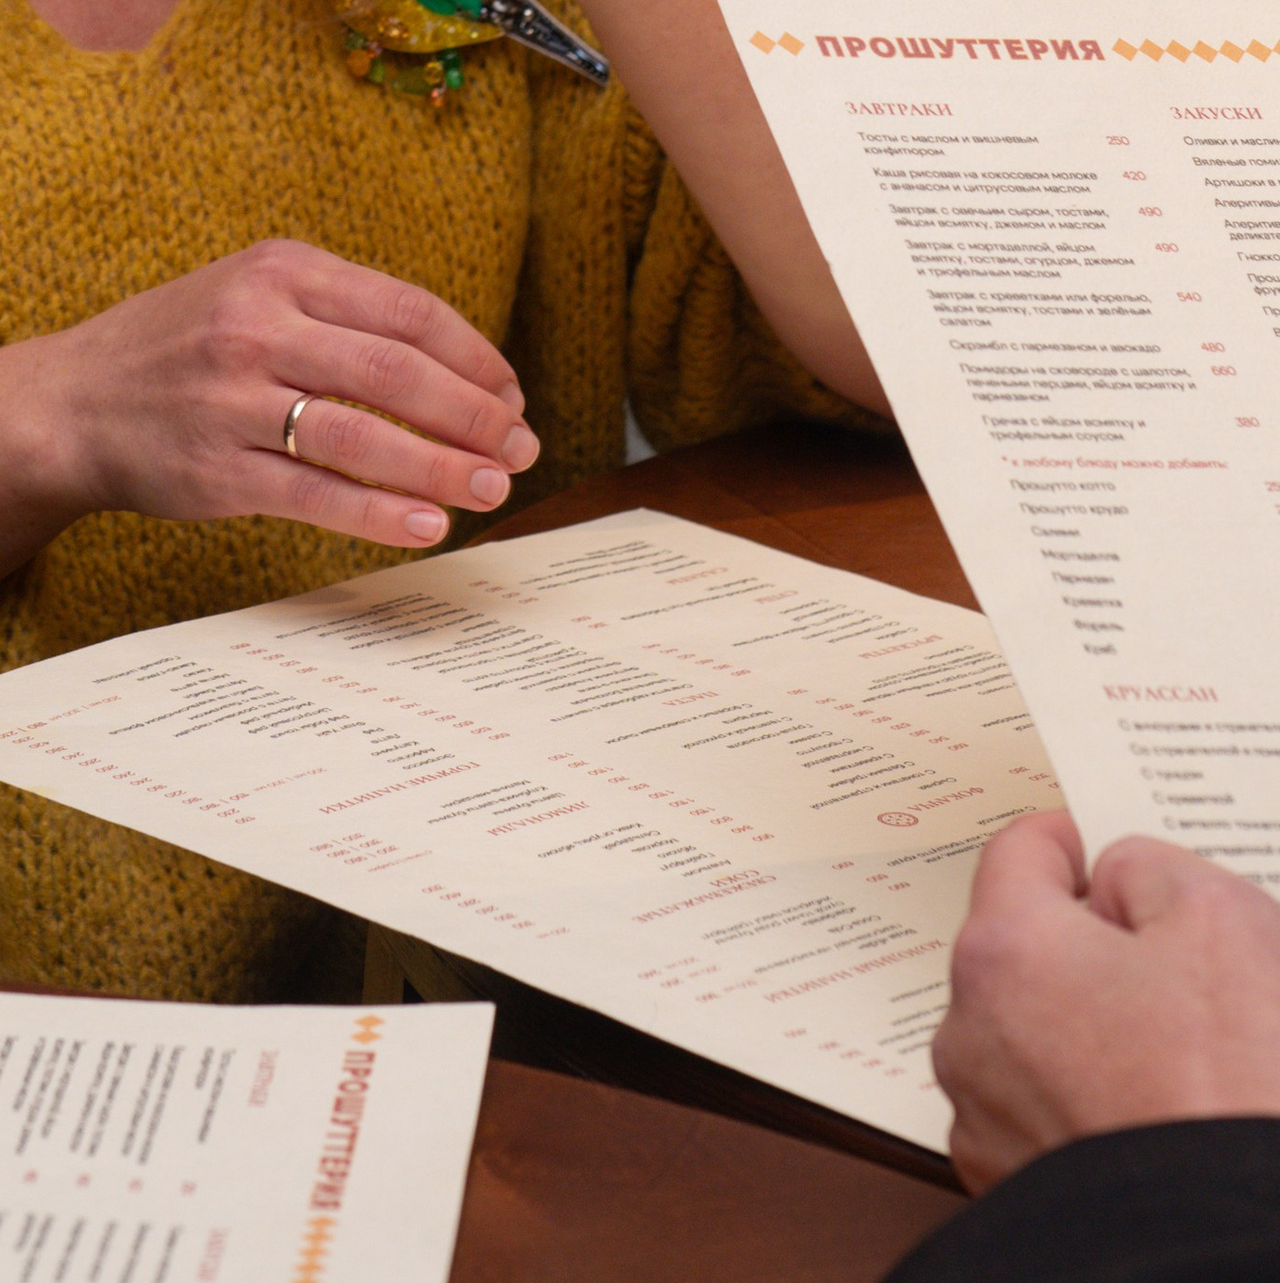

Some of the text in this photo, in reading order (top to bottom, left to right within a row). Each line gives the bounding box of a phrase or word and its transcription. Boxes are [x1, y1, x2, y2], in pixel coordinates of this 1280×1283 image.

[814, 35, 1106, 61] ПРОШУТТЕРИЯ
[845, 101, 953, 116] ЗАВТРАКИ
[1169, 106, 1263, 120] ЗАКУСКИ
[857, 131, 899, 143] Тосты
[900, 135, 909, 143] с
[911, 135, 960, 144] маслом
[971, 135, 1039, 144] вишневым
[1105, 135, 1131, 146] 250
[1183, 135, 1229, 146] Оливки
[1229, 138, 1239, 146] и
[863, 146, 945, 157] конфитюром
[1191, 156, 1247, 167] Вяленые
[872, 167, 1147, 181] Каша рисовая на кокосовом молоке 420
[879, 182, 1091, 194] с ананасом и цитрусовым маслом
[1204, 177, 1277, 188] Артишоки в
[888, 203, 939, 216] Завтрак
[940, 207, 949, 215] с
[951, 207, 1006, 216] овечьим
[1138, 206, 1163, 217] 490
[894, 217, 936, 228] яйцом
[994, 221, 1046, 229] джемом
[1057, 221, 1106, 230] маслом
[904, 239, 955, 251] Завтрак
[956, 242, 966, 251] с
[1055, 242, 1096, 253] яйцом
[1154, 242, 1179, 253] 490
[1083, 257, 1135, 266] джемом
[916, 267, 1062, 279] и трюфельным маслом
[926, 289, 976, 301] Завтрак
[978, 292, 988, 300] с
[989, 292, 1064, 302] креветками
[1065, 294, 1088, 302] или
[1176, 291, 1202, 303] 540
[932, 303, 974, 314] яйцом
[1032, 306, 1084, 315] тостами
[939, 318, 992, 327] салатом
[949, 339, 1008, 351] Скрэмбл
[1009, 342, 1019, 351] с
[1020, 342, 1098, 352] пармезаном
[1109, 344, 1162, 353] авокадо
[1200, 342, 1226, 353] 480
[959, 362, 1029, 376] Помидоры
[1030, 367, 1047, 375] на
[1048, 366, 1119, 377] сковороде
[1120, 367, 1130, 377] с
[1210, 365, 1237, 376] 660
[1091, 379, 1133, 391] яйцом
[1133, 381, 1185, 392] всмятку
[972, 392, 1050, 403] пармезаном
[981, 414, 1261, 429] Гречка с яйцом всмятку и 380
[989, 430, 1125, 442] трюфельным соусом
[1011, 458, 1019, 467] к
[1022, 456, 1074, 470] любому
[1075, 457, 1118, 470] блюду
[1120, 459, 1165, 469] можно
[1009, 478, 1077, 492] Прошутто
[1078, 482, 1116, 491] котто
[1019, 502, 1129, 516] Прошутто крудо
[1102, 684, 1219, 702] КРУАССАН
[310, 1050, 377, 1211] ПРОШУТТЕРИЯ
